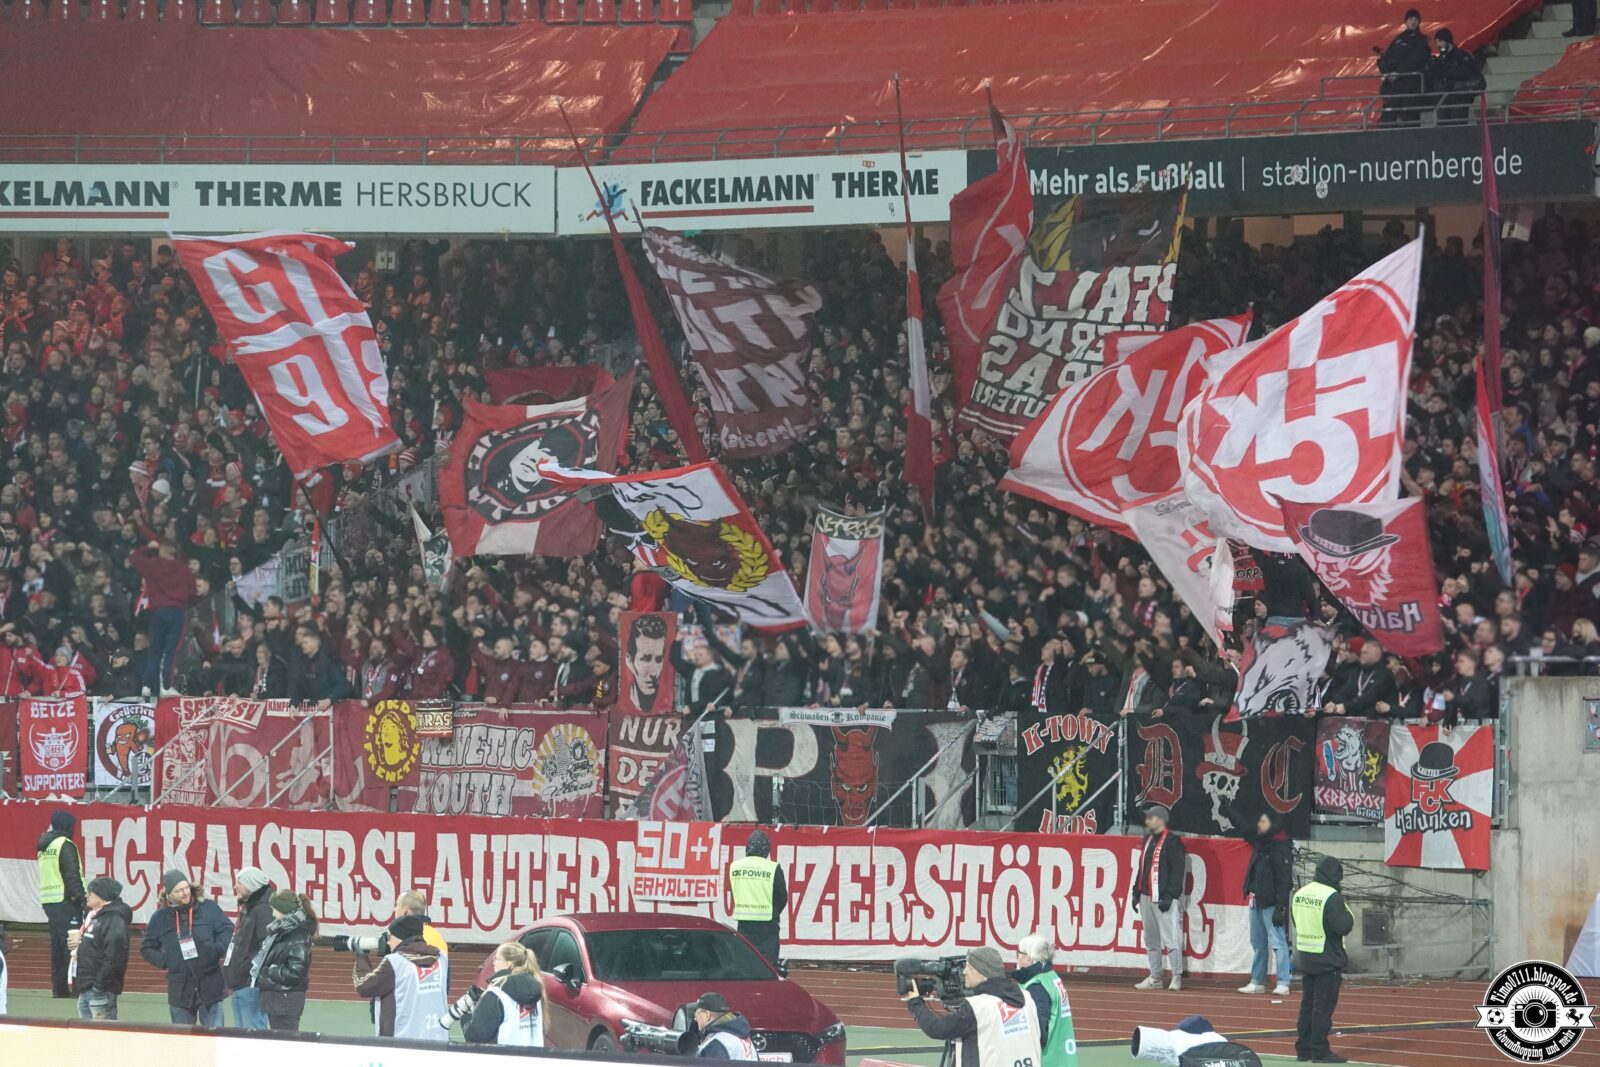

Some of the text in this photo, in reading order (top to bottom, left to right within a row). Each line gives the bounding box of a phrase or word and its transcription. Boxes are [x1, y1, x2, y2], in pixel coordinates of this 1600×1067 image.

[1030, 161, 1225, 196] Mehr als Fußball
[1263, 147, 1522, 188] stadion-nuernbergde
[195, 181, 341, 206] THERME
[357, 182, 531, 207] HERSBRUCK
[641, 169, 938, 206] FACKELMANN THERME
[31, 700, 76, 719] BETZE
[789, 710, 830, 722] Schwaben
[619, 716, 682, 749] NUR
[1021, 713, 1115, 755] K-TOWN
[24, 772, 86, 792] SUPPORTERS
[616, 755, 666, 787] DE
[414, 770, 516, 816] YOUTH
[1396, 807, 1471, 834] Halunken
[635, 821, 723, 869] 50+1
[633, 877, 719, 899] ERHALTEN
[716, 842, 1214, 960] UZERSTÖRBR
